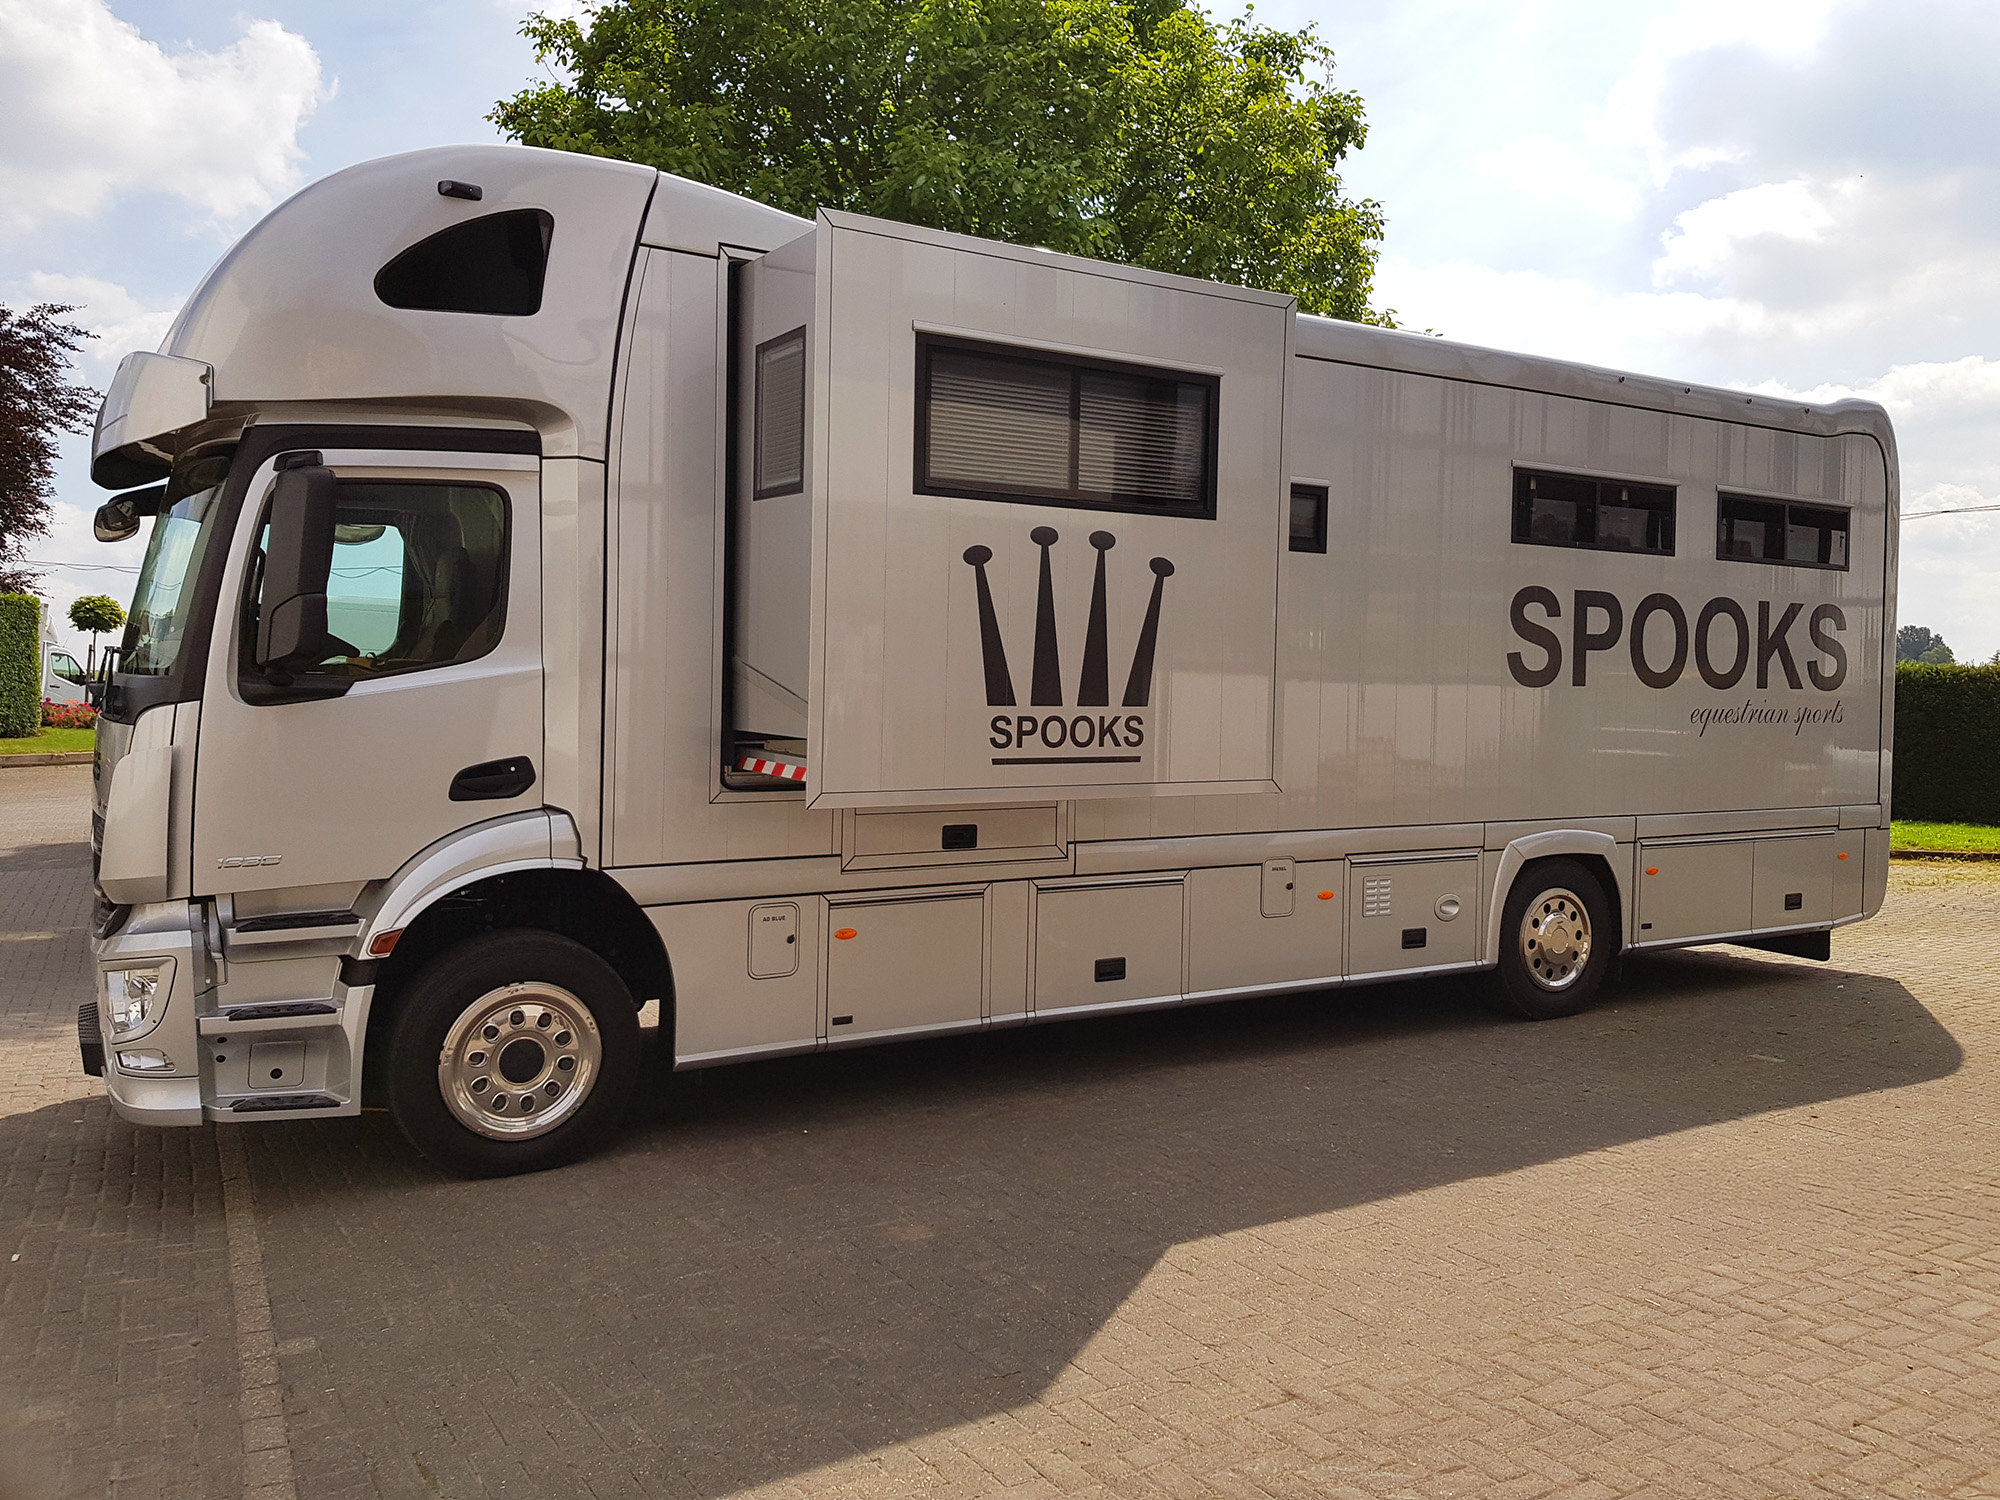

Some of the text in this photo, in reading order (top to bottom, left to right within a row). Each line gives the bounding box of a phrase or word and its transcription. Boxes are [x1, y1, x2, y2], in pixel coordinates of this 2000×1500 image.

[1506, 585, 1848, 692] SPOOKS
[989, 715, 1145, 749] SPOOKS
[1690, 699, 1845, 737] equestrian sports
